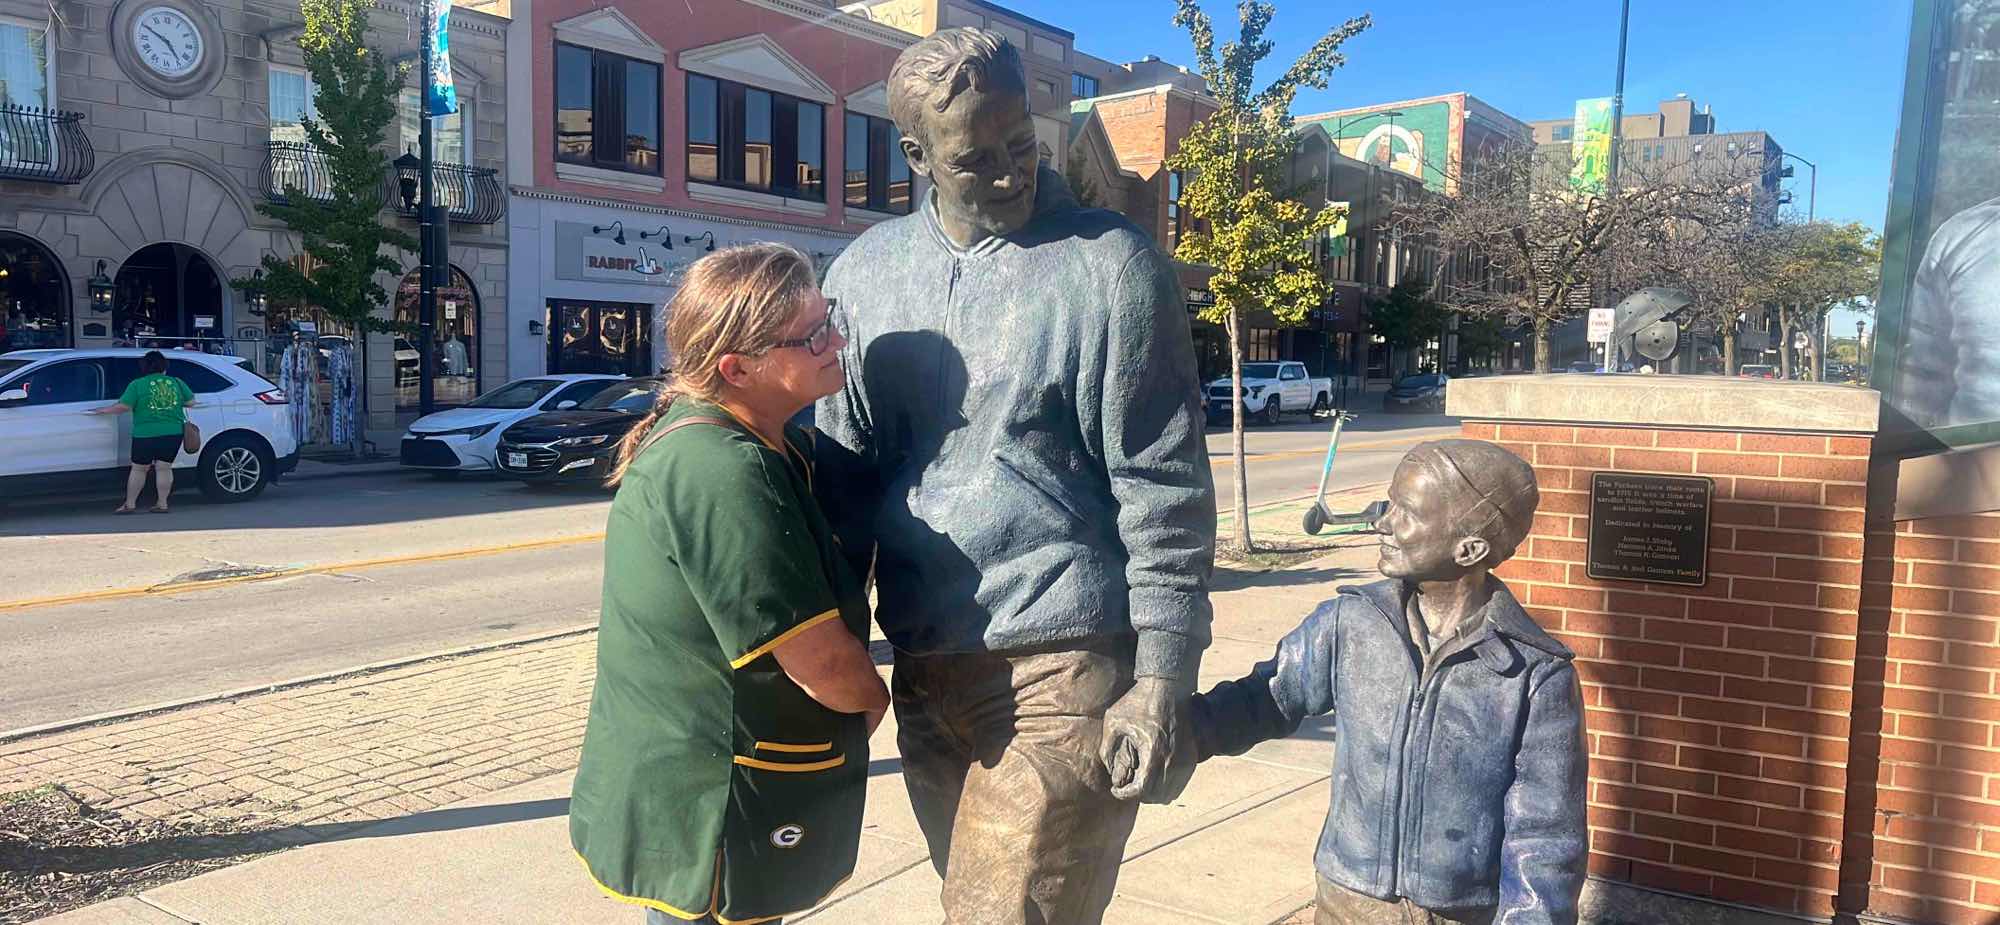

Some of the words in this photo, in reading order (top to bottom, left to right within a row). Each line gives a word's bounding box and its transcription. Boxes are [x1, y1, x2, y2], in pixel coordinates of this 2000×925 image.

[588, 256, 637, 271] RABBIT
[1188, 290, 1216, 303] HEIGH
[1677, 569, 1701, 578] Family
[770, 824, 804, 848] G
